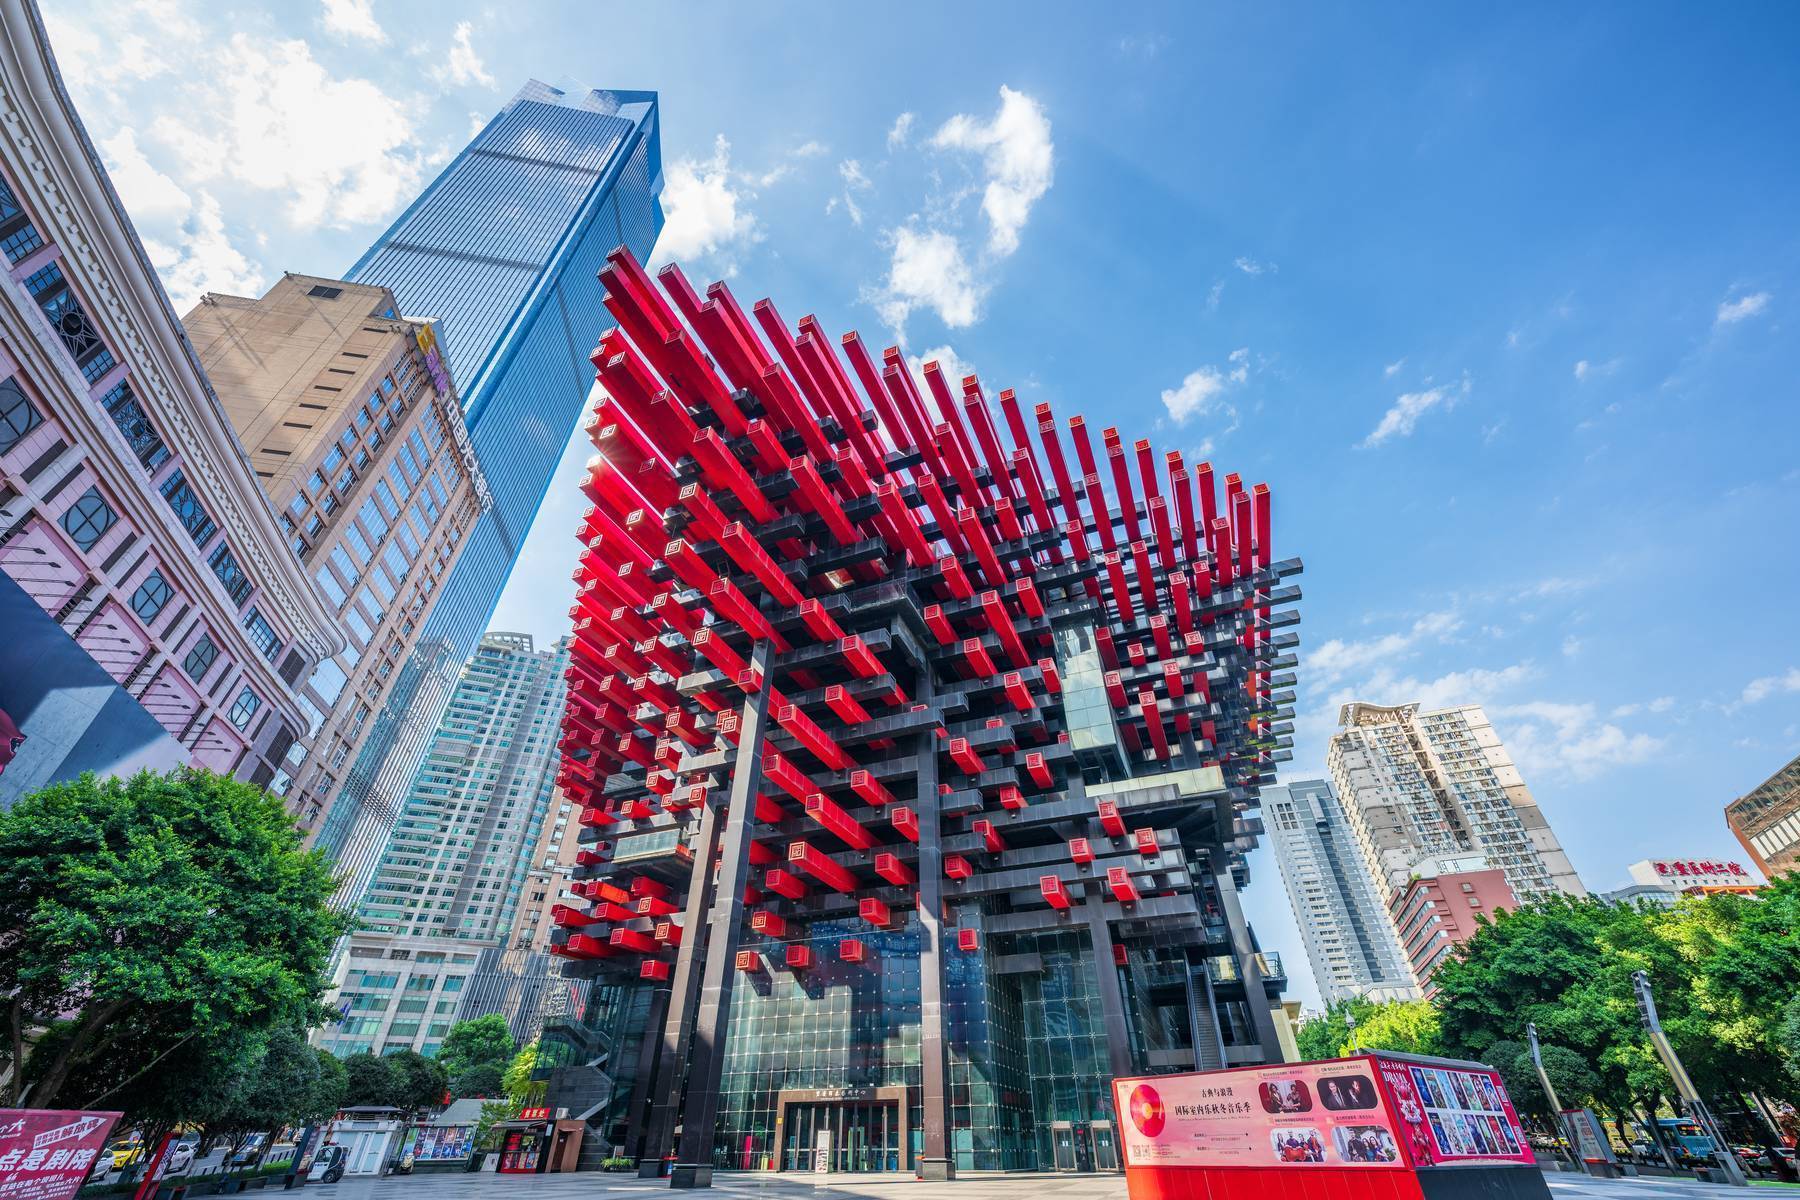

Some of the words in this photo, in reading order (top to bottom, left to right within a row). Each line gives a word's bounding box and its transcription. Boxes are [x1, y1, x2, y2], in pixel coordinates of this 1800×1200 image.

[1201, 1087, 1234, 1098] 古典与浪漫
[1174, 1101, 1252, 1116] 国际室内乐秋冬音乐季
[0, 1148, 97, 1171] 点是剧院
